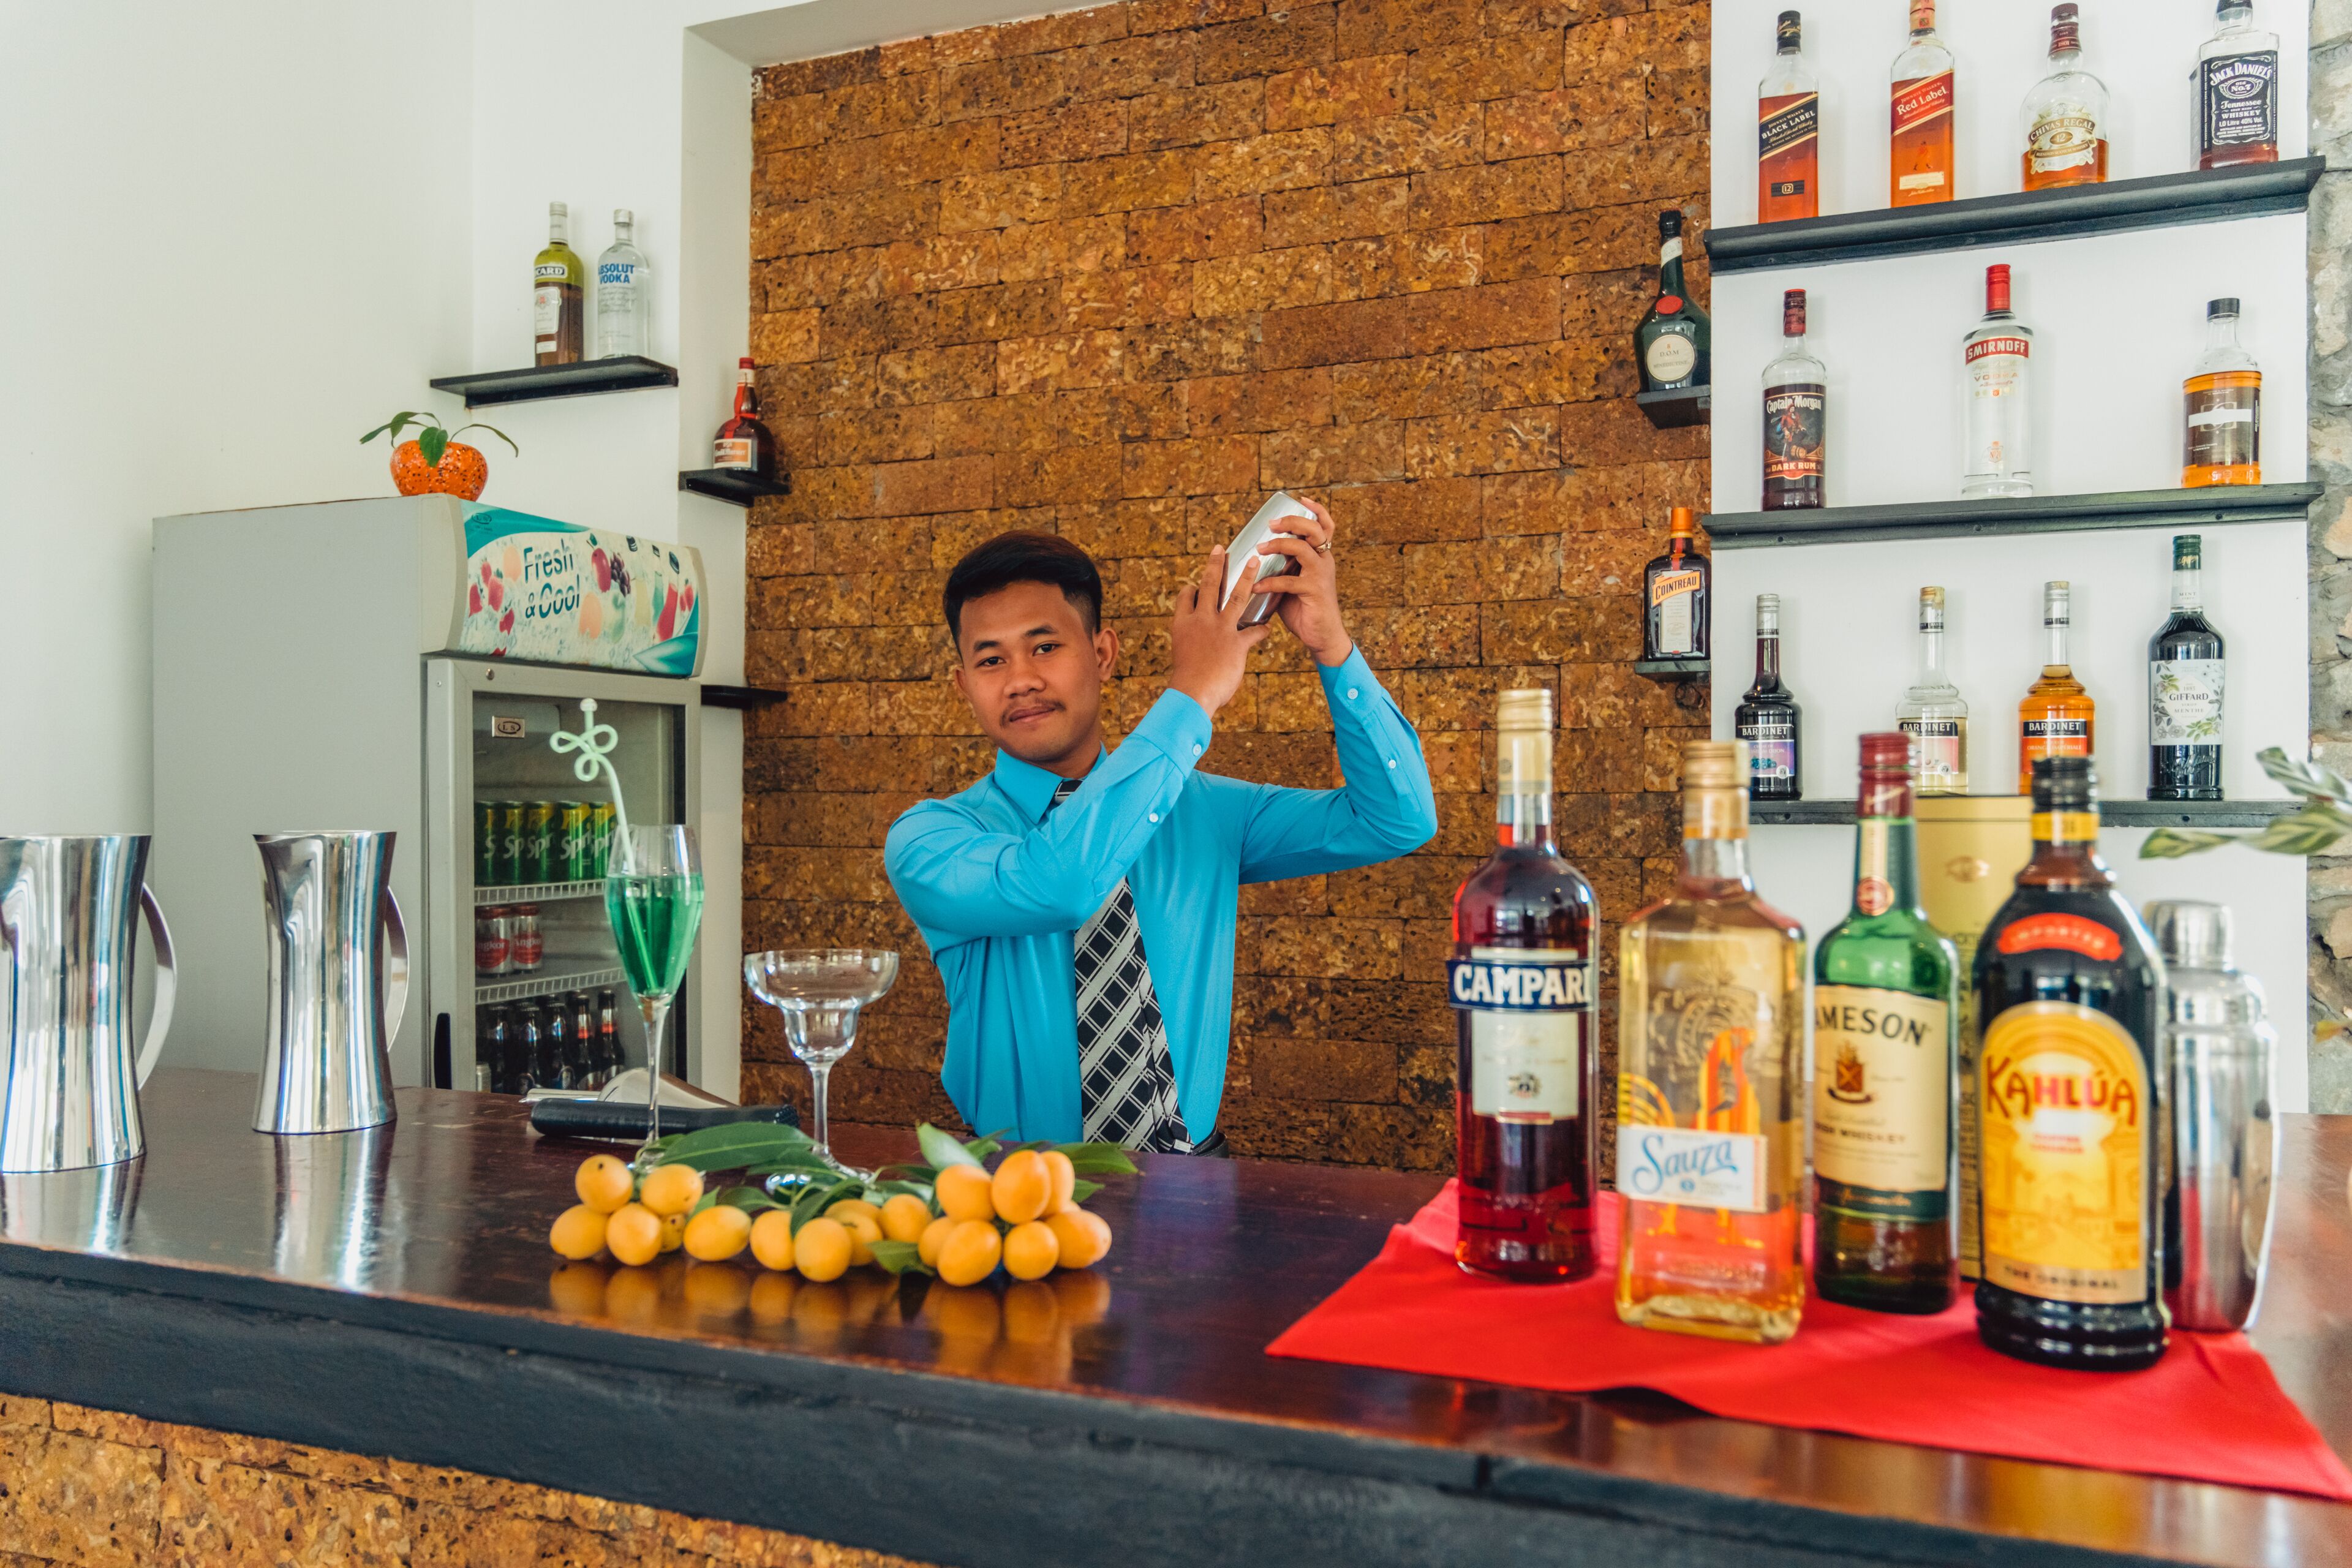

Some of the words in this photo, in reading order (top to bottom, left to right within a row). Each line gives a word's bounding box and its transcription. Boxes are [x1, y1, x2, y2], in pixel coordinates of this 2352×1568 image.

[2209, 67, 2235, 86] JACK
[2234, 62, 2272, 80] DANIEL'S
[2231, 84, 2252, 92] No.7
[1896, 99, 1918, 115] Red
[1919, 86, 1947, 105] Label
[2220, 100, 2262, 110] Tennessee
[2222, 110, 2261, 119] WHISKEY
[1762, 123, 1788, 139] BLACK
[1789, 110, 1815, 126] LABEL
[2030, 121, 2060, 140] CHIVAS
[2064, 118, 2094, 130] REGAL
[2057, 133, 2065, 142] 12
[535, 267, 564, 276] CARD
[1968, 340, 2026, 360] SMIRNOFF
[1767, 396, 1793, 414] Captain
[1792, 395, 1822, 410] Morgan
[1771, 462, 1796, 472] DARK
[524, 538, 574, 584] Fresh
[539, 573, 579, 619] Cool
[1656, 576, 1697, 600] COINTREAU
[1742, 727, 1787, 736] BARDINET
[1903, 723, 1951, 731] BARDINET
[2029, 722, 2080, 731] BARDINET
[1986, 1055, 2136, 1126] KAHLÚA
[1631, 1134, 1738, 1194] Sauza
